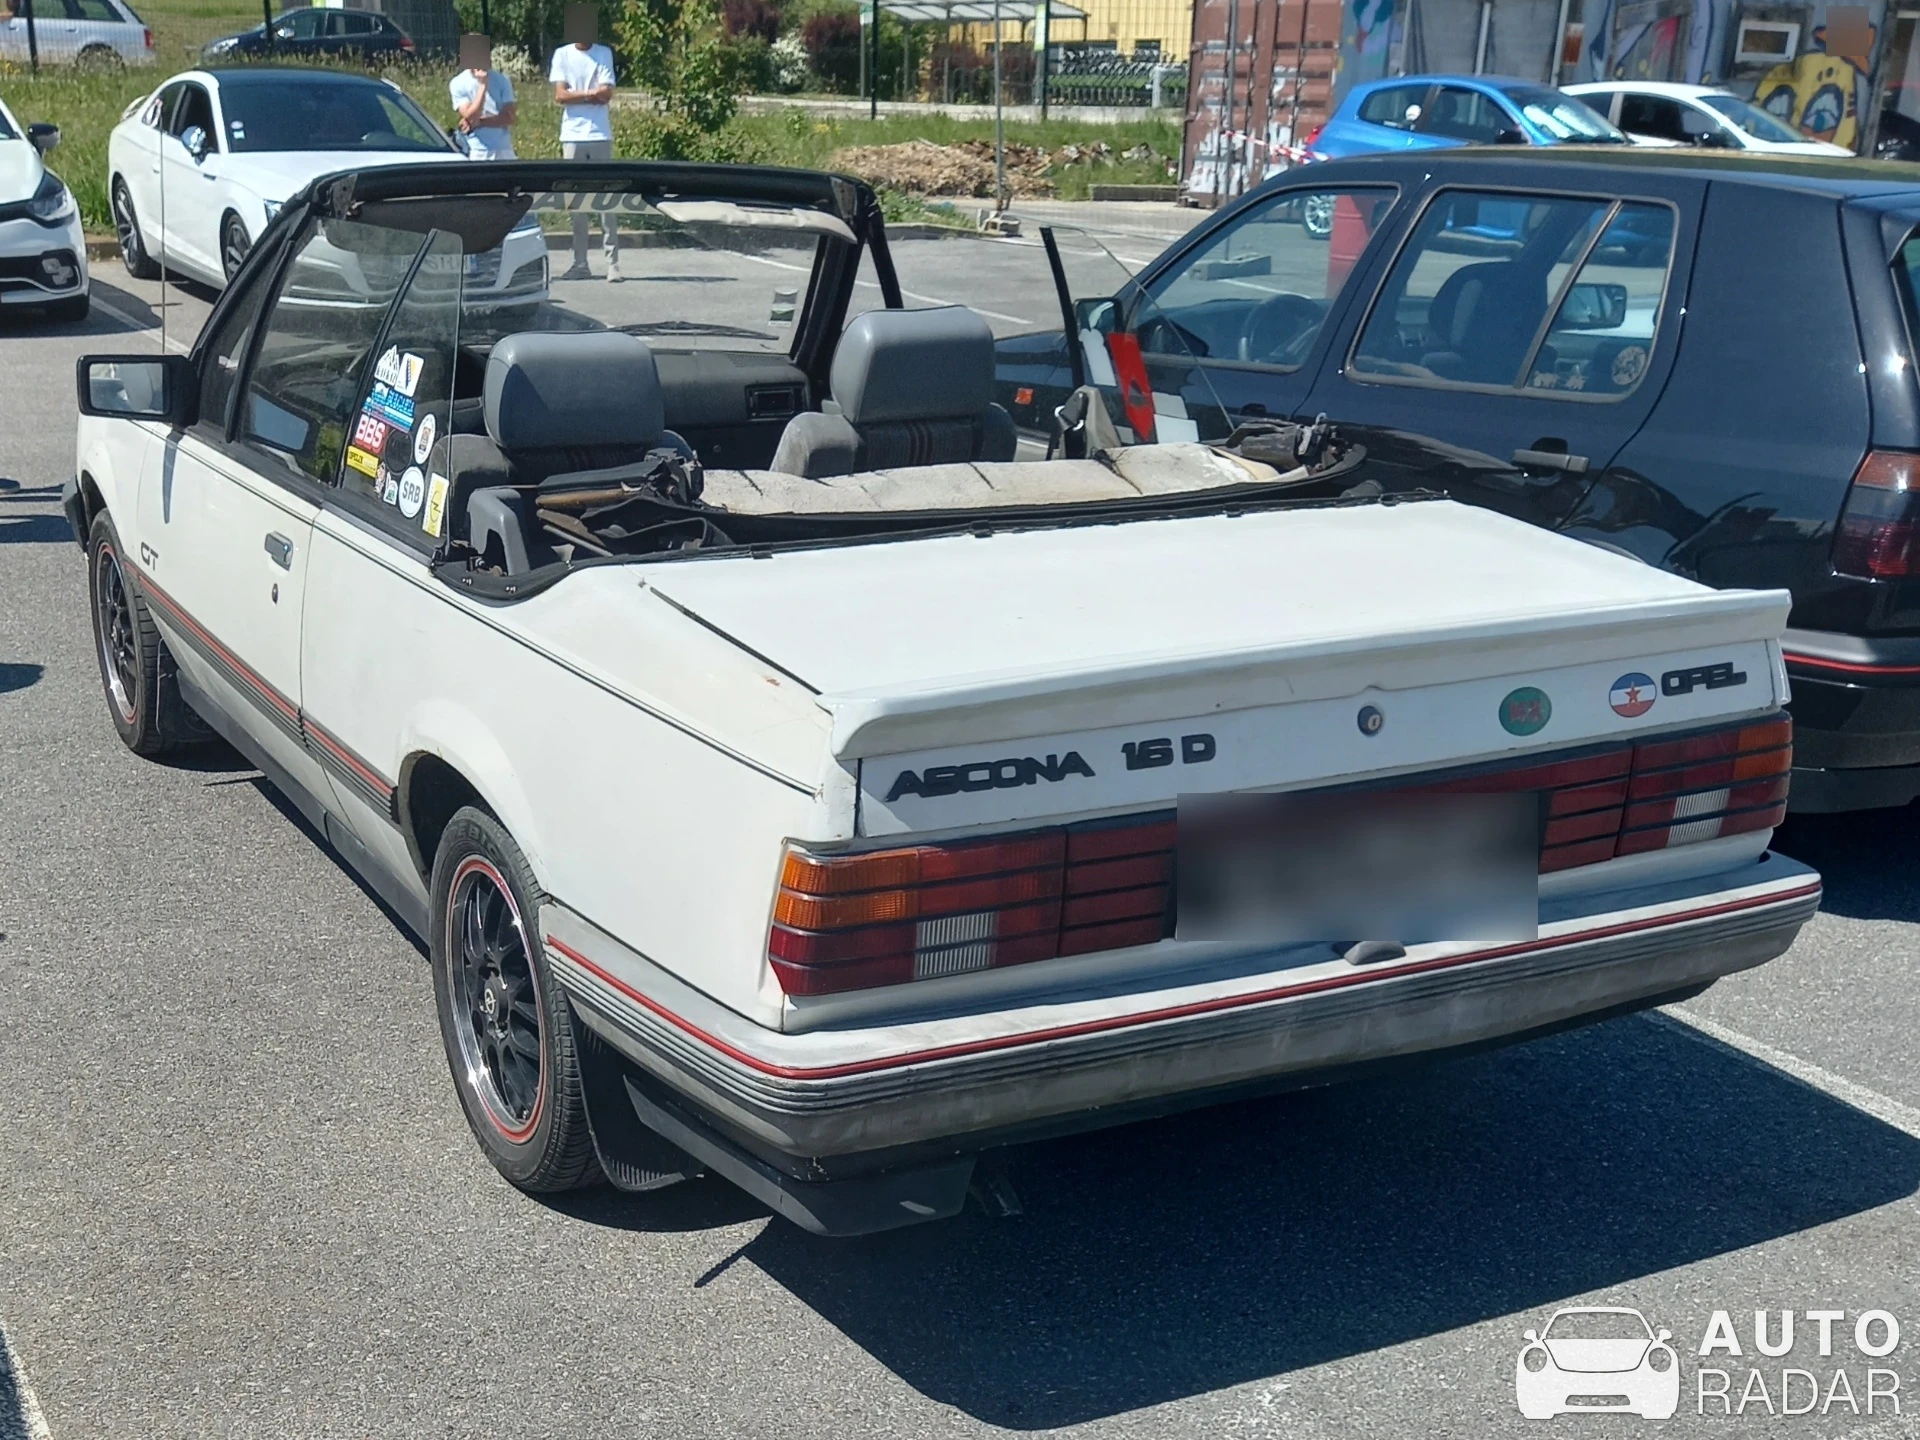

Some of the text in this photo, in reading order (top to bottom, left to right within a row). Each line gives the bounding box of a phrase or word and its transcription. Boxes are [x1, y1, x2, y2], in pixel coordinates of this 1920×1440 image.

[355, 413, 386, 450] BBS
[402, 481, 421, 504] SRB
[140, 541, 159, 571] GT
[1660, 661, 1748, 698] OPEL
[885, 750, 1097, 803] ASCONA
